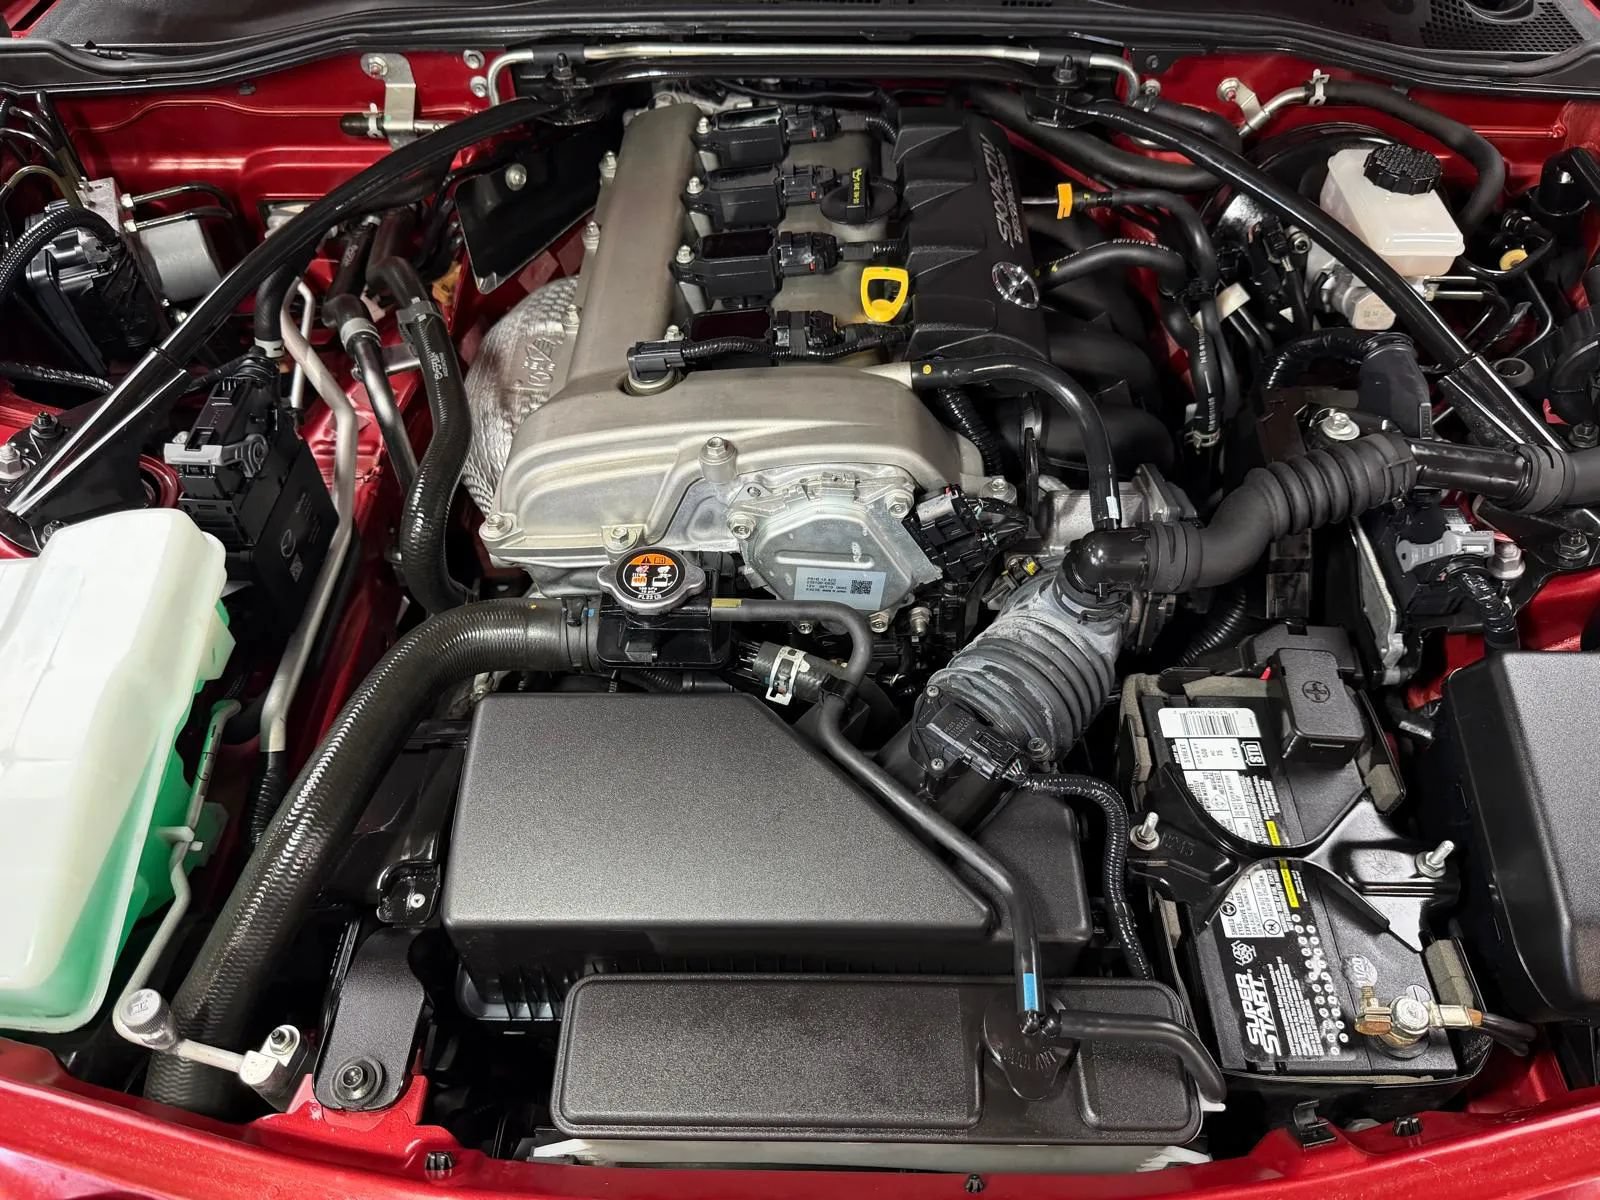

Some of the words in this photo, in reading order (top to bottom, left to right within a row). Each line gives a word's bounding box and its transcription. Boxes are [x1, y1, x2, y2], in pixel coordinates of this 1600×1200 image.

[979, 132, 1014, 248] SKYACTIV
[1246, 744, 1262, 762] STD
[1234, 892, 1244, 907] GASES
[1228, 918, 1237, 935] SHIELD
[1239, 908, 1251, 935] EXPLOSIVE
[1235, 972, 1260, 1045] SUPER
[1246, 973, 1276, 1055] START
